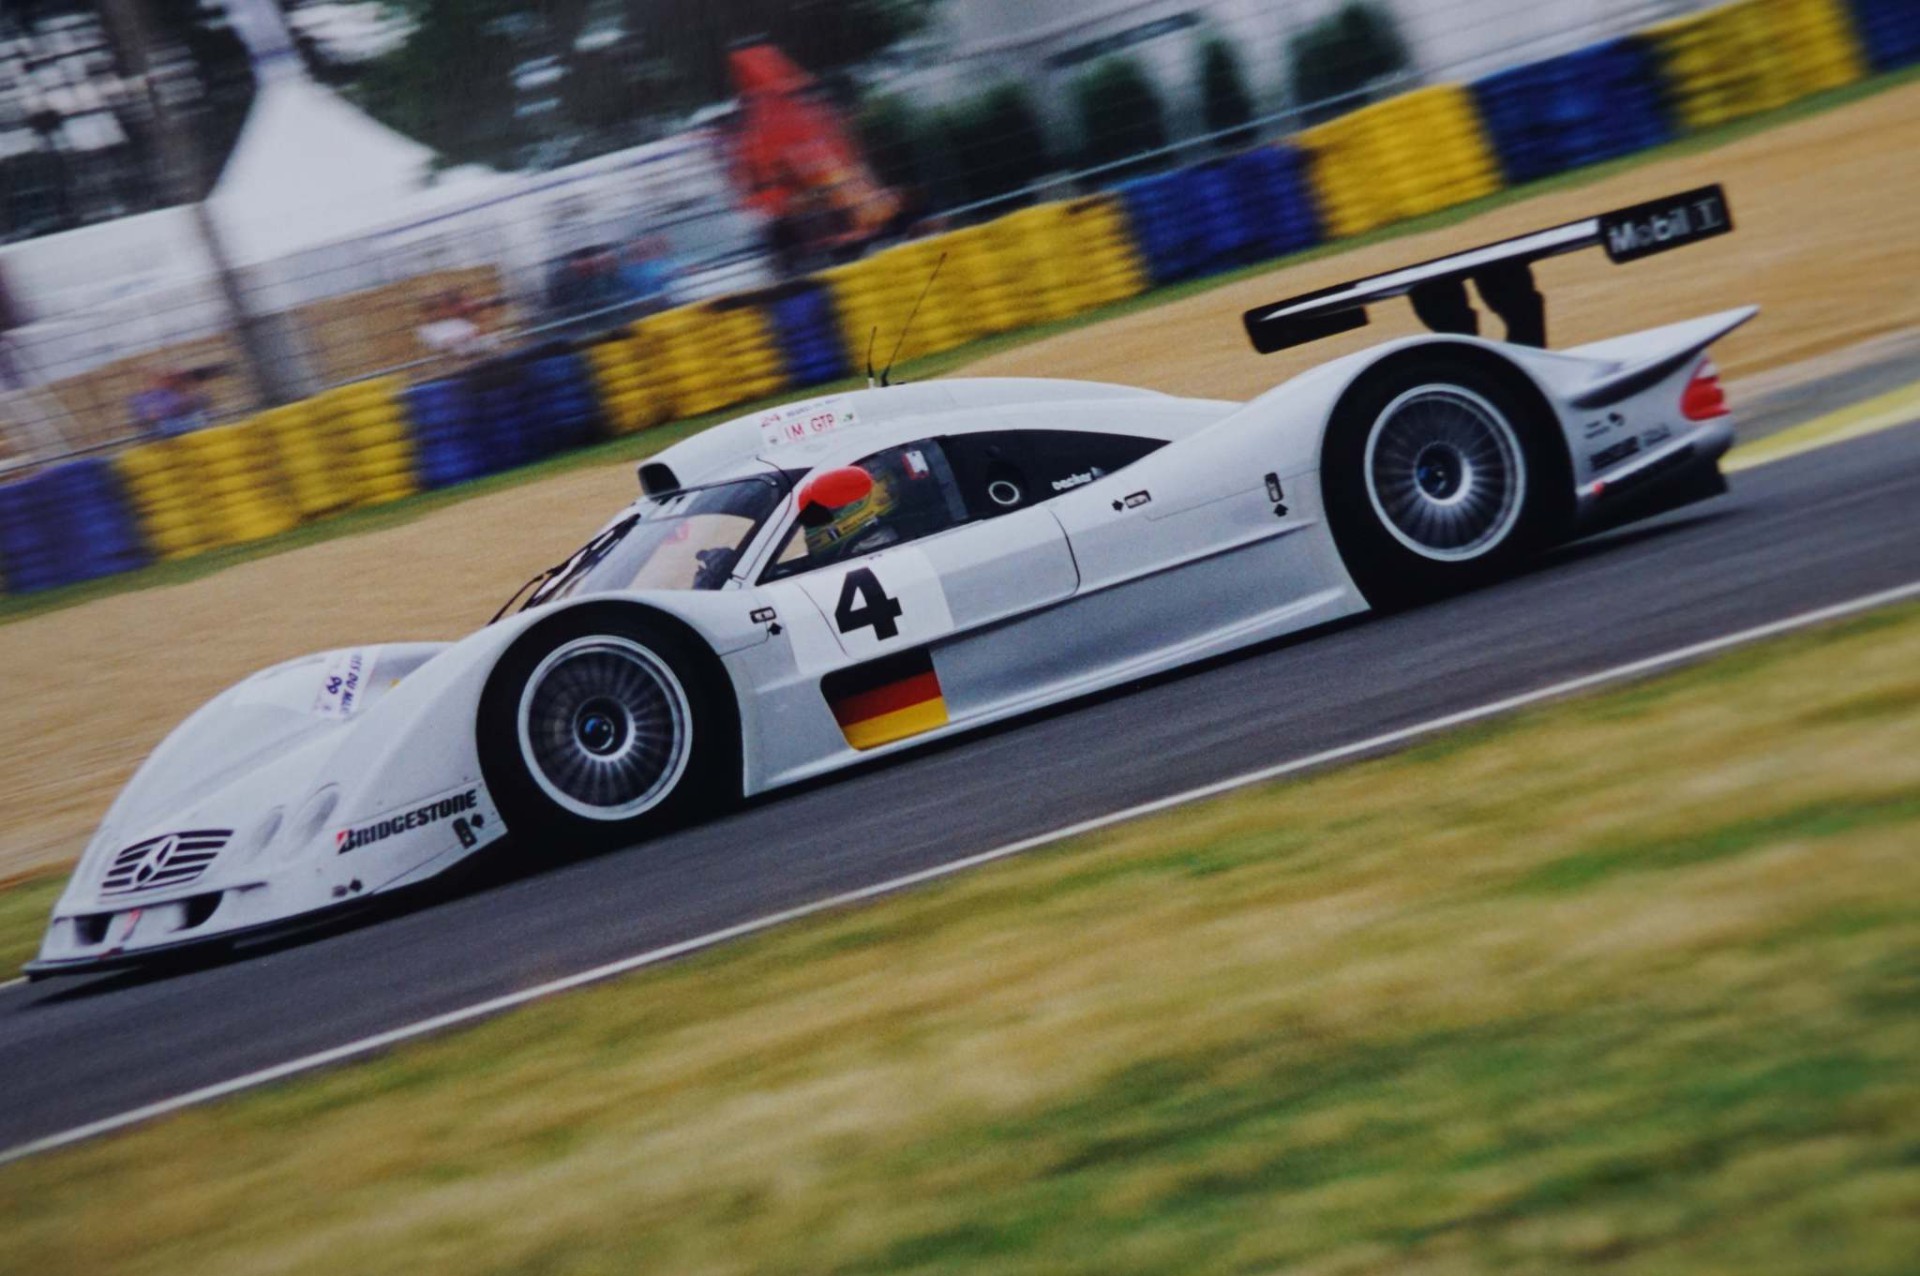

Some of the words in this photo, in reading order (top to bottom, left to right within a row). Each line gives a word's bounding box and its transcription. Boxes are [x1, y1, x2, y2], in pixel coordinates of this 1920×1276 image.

[1607, 205, 1691, 253] Mobil
[835, 566, 903, 642] 4
[336, 789, 477, 855] BRIDGESTONE
